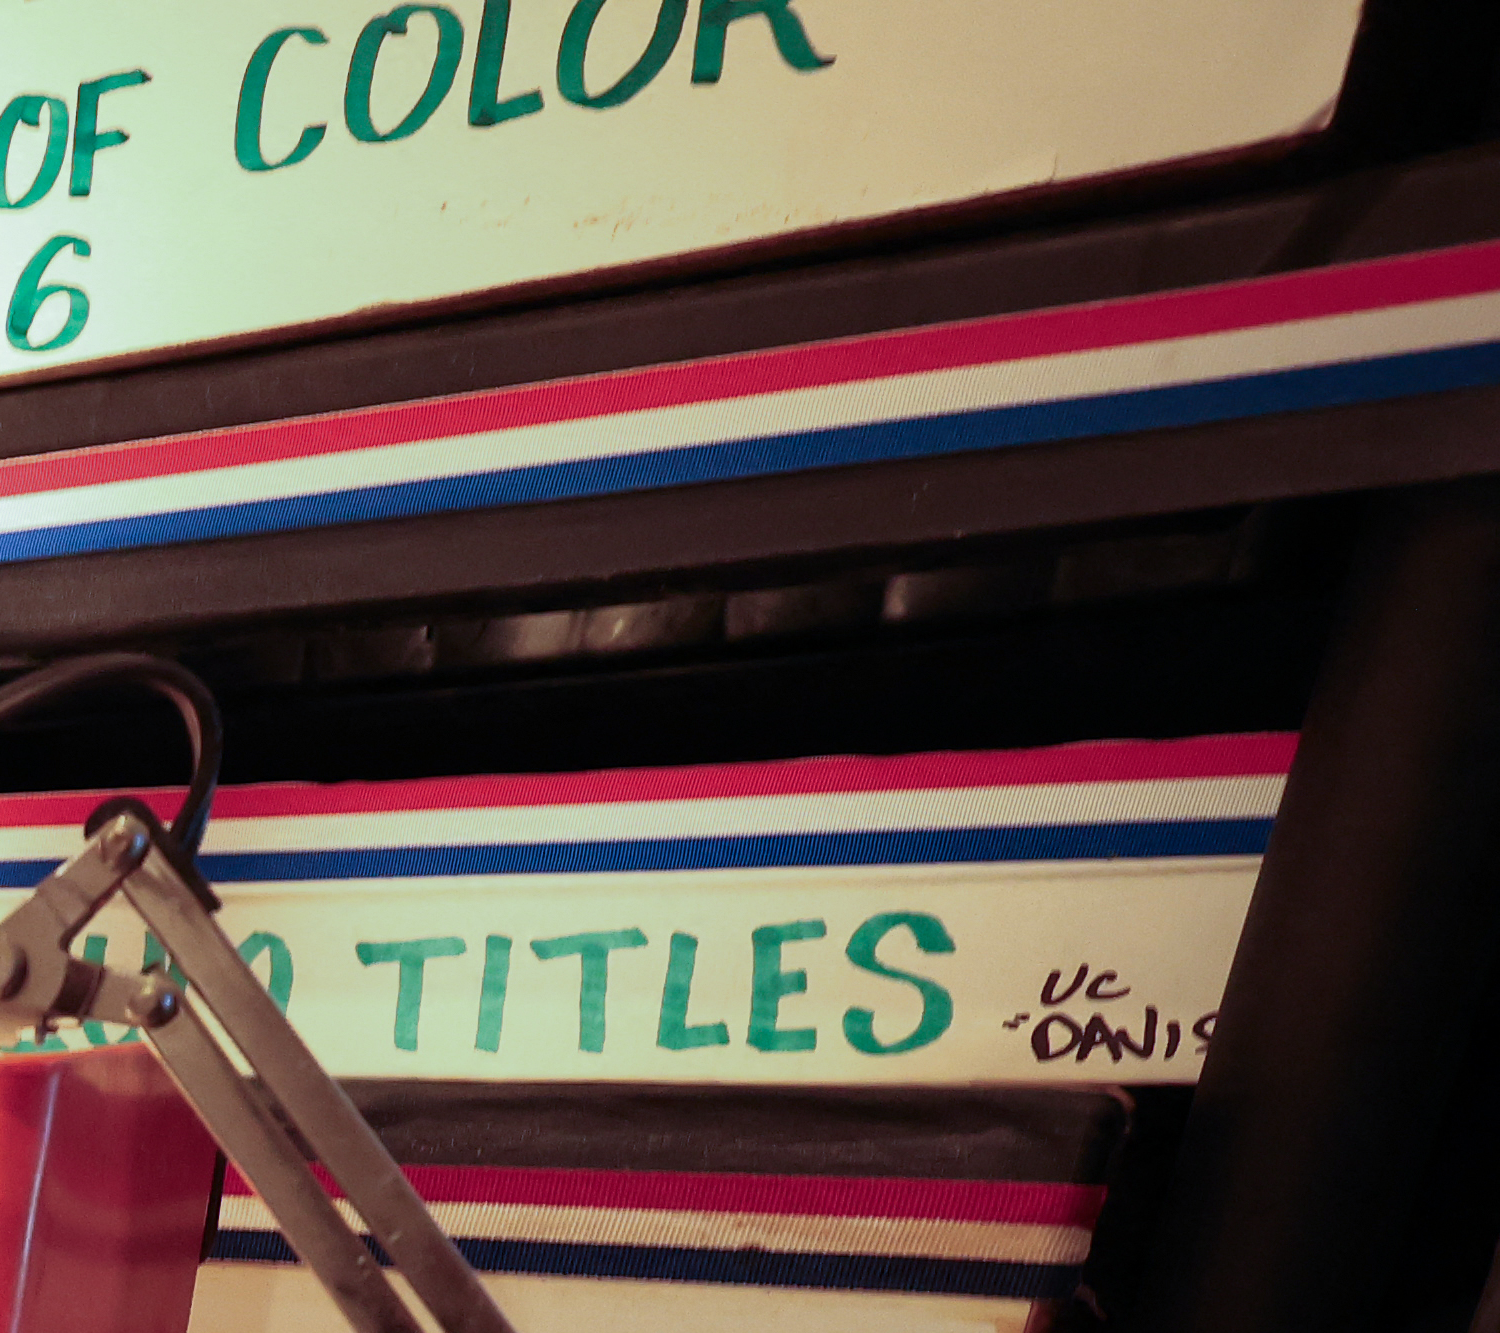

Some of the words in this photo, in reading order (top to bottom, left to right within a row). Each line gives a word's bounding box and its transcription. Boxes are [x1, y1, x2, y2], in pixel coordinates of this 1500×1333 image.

[234, 0, 836, 172] COLOR
[5, 232, 92, 354] 6
[355, 911, 958, 1058] TITLES
